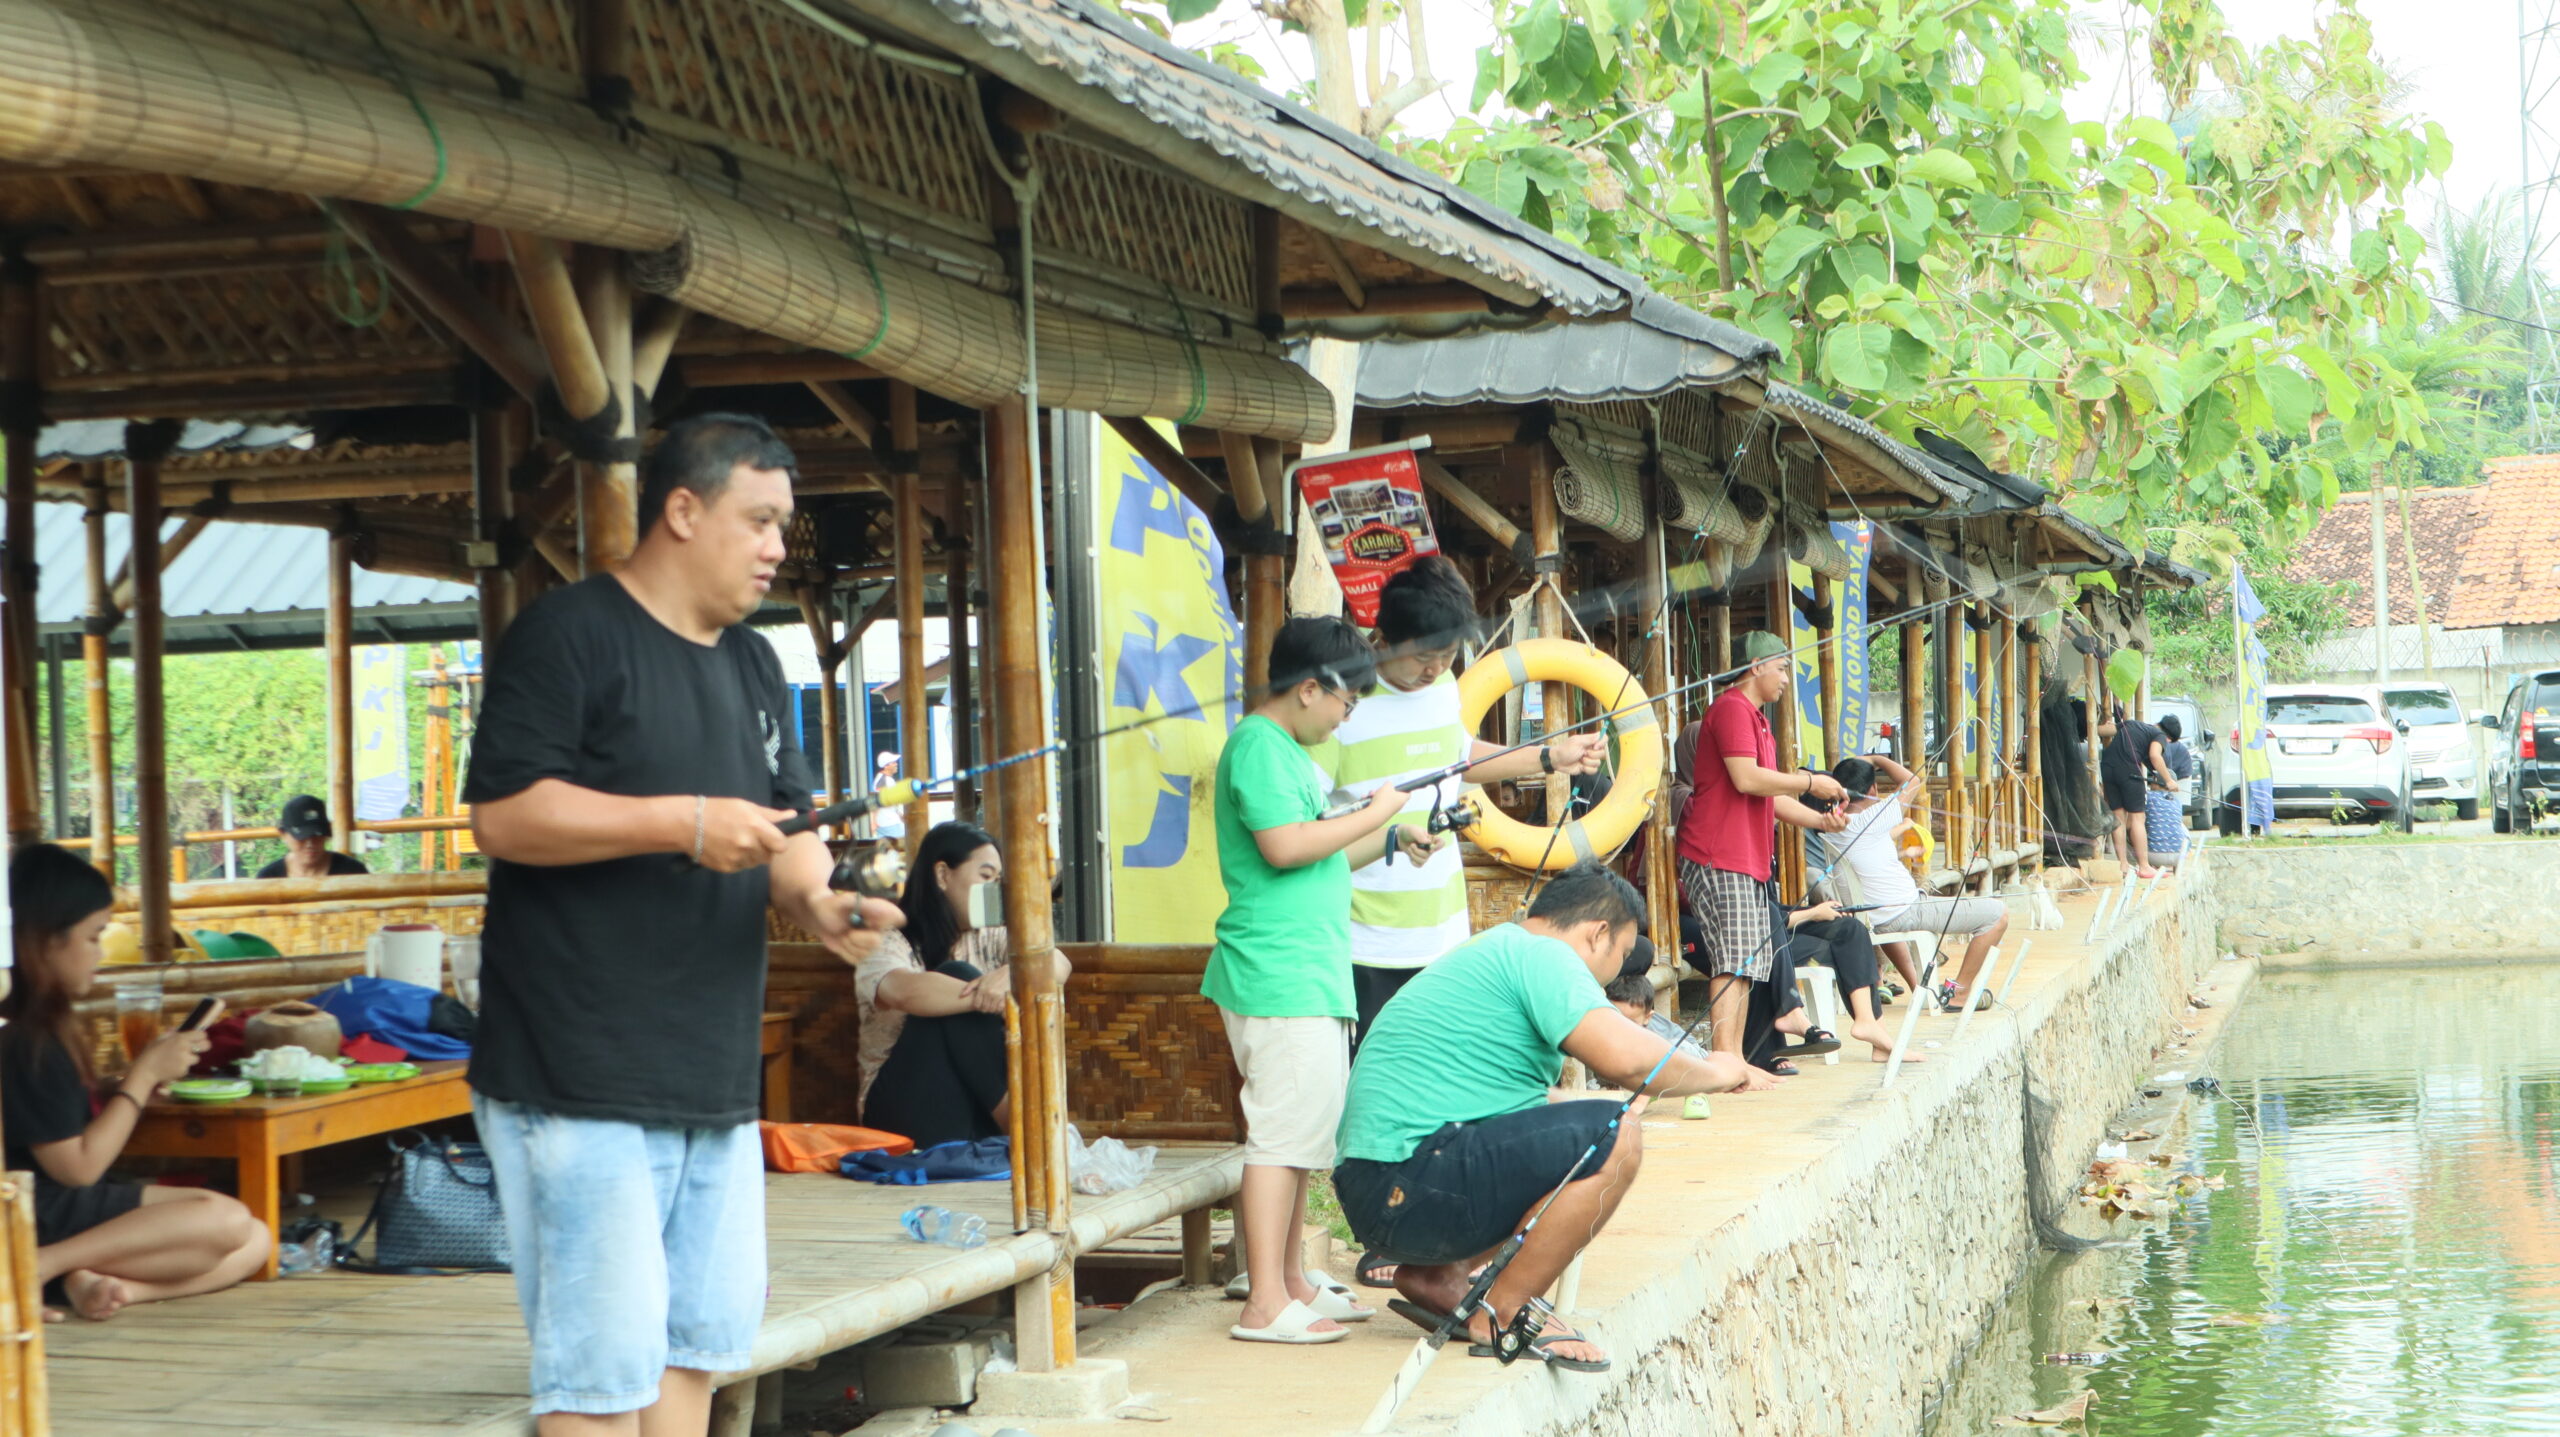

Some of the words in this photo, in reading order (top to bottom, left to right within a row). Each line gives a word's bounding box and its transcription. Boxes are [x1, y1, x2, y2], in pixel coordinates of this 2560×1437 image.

[1351, 532, 1403, 554] KARAOKE
[1848, 543, 1865, 601] JAYA
[1846, 605, 1863, 693] KOHOD
